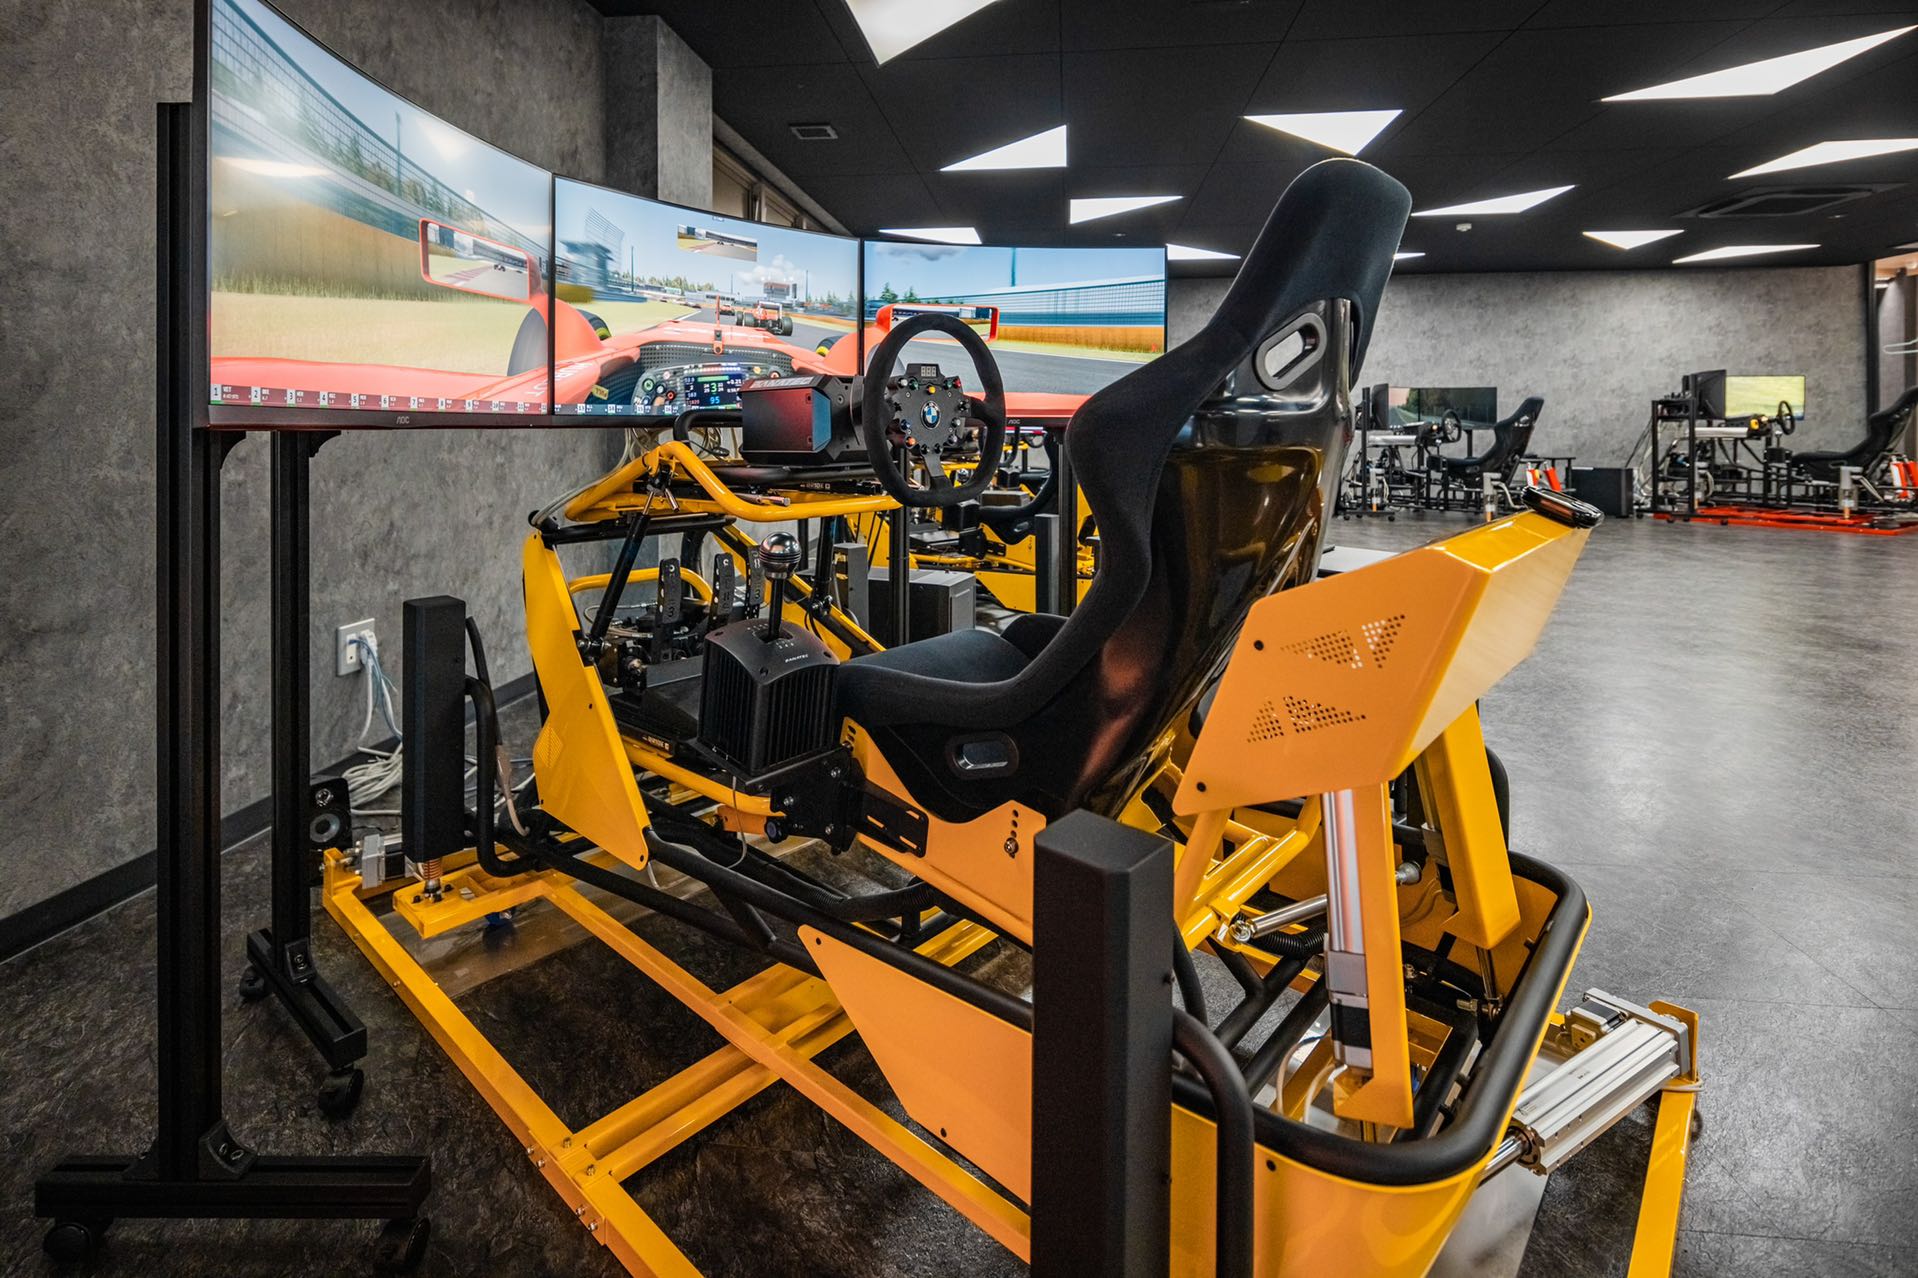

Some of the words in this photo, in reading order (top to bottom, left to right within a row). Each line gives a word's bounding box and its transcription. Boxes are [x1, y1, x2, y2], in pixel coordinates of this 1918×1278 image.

[710, 382, 717, 393] 3
[710, 396, 720, 404] 95
[396, 416, 410, 425] AOC
